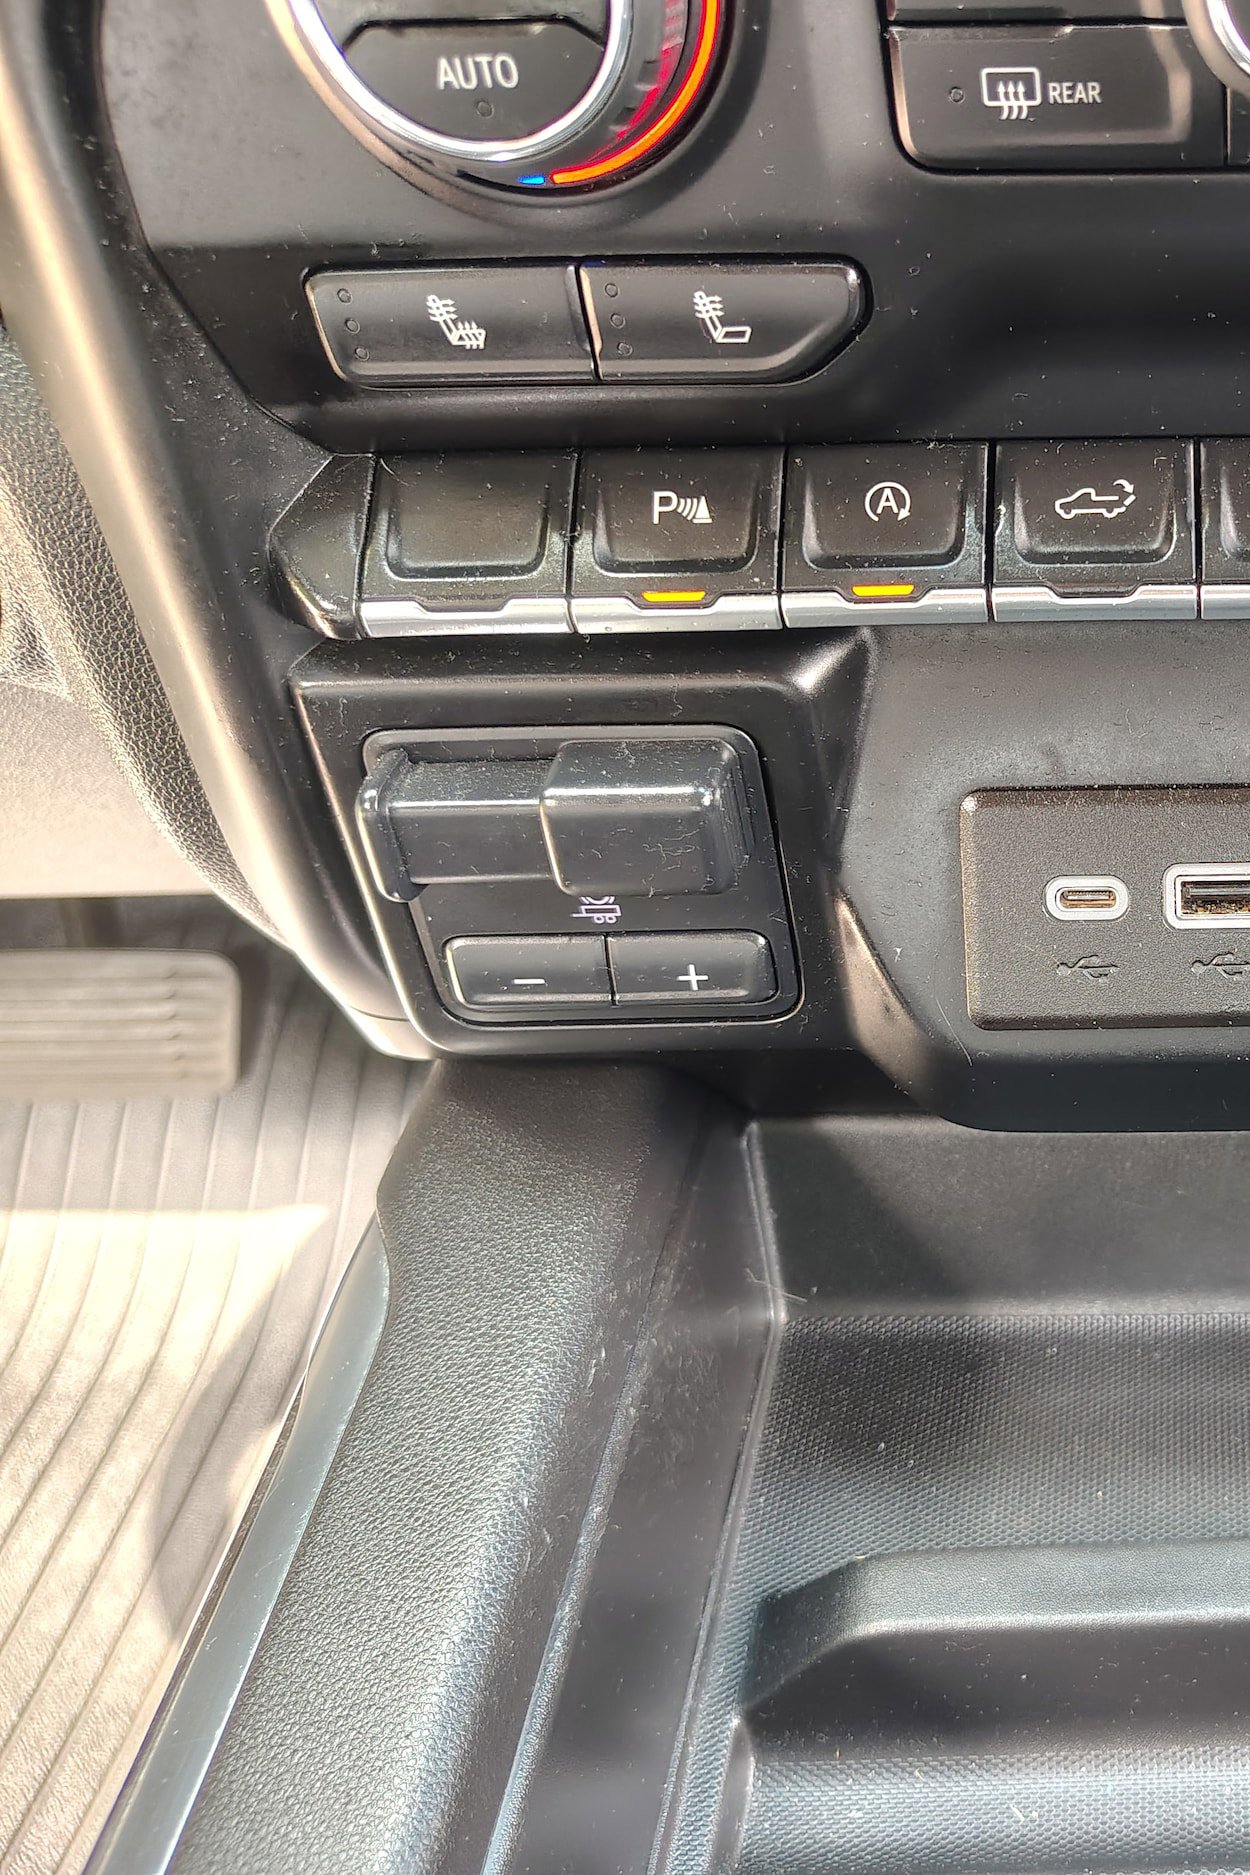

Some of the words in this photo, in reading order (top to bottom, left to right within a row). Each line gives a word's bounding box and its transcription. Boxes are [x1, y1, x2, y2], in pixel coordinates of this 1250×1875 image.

[437, 53, 519, 89] AUTO
[1047, 82, 1102, 104] REAR
[876, 487, 899, 514] A
